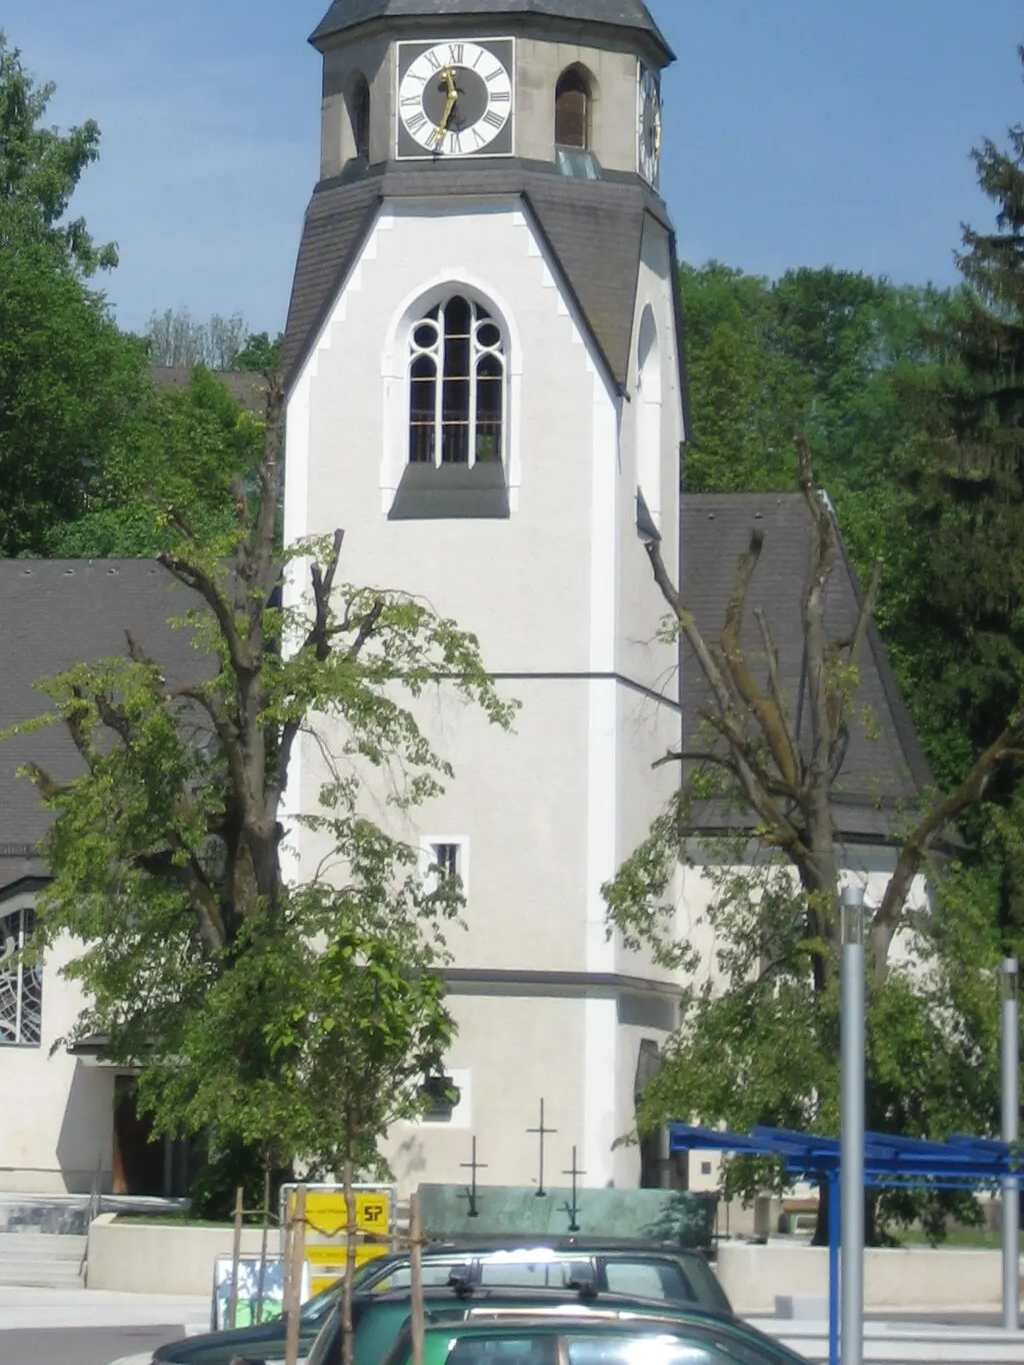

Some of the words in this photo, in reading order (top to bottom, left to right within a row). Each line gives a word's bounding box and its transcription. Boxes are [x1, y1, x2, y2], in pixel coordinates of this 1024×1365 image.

[424, 50, 441, 72] XI
[448, 43, 464, 64] XII
[472, 50, 484, 68] I
[406, 70, 427, 86] X
[484, 66, 504, 83] II
[490, 92, 510, 102] III
[471, 128, 487, 149] V
